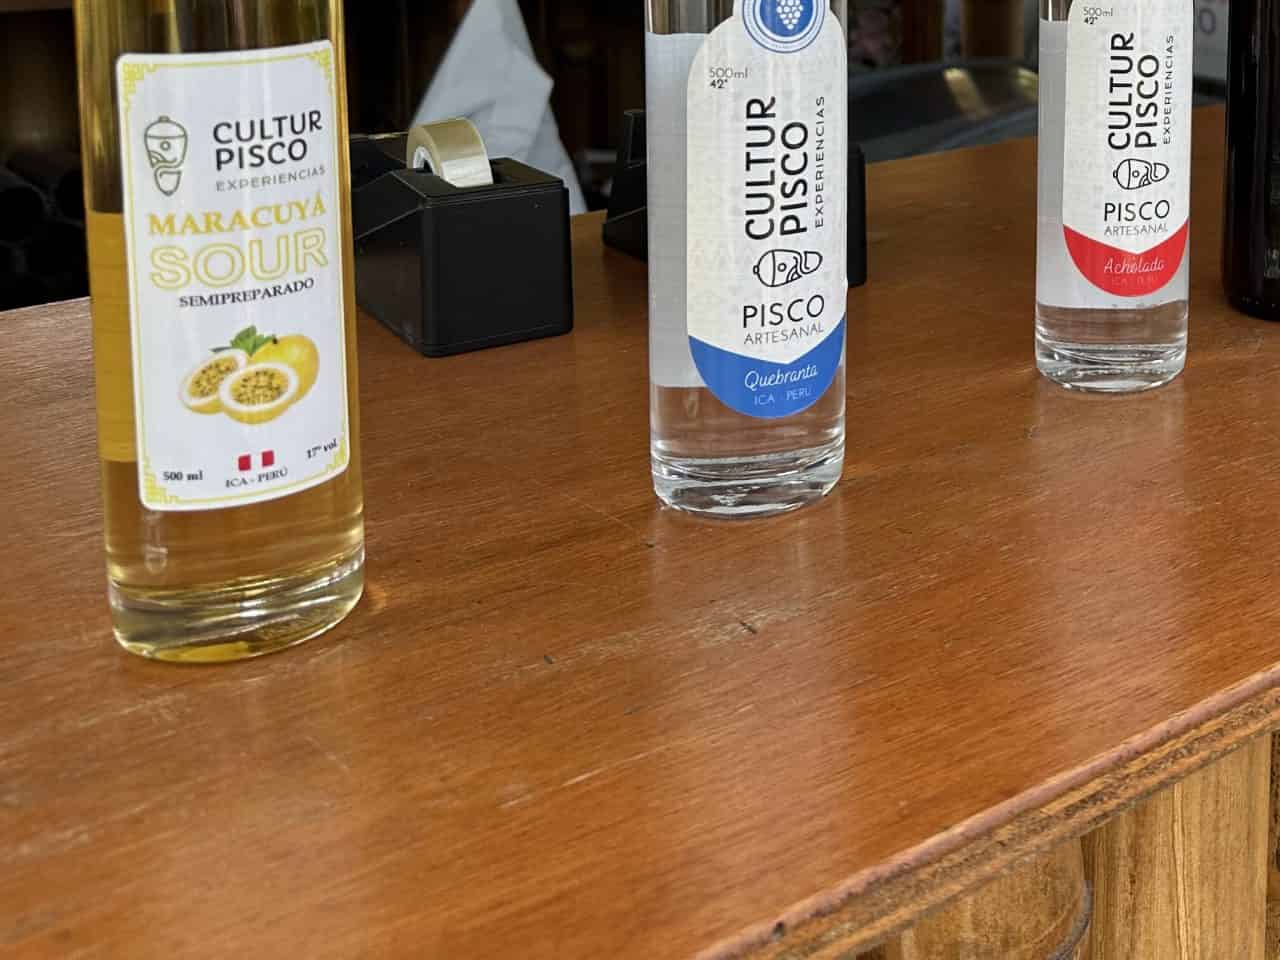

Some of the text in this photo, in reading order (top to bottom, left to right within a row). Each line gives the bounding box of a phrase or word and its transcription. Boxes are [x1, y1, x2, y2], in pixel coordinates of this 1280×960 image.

[1083, 6, 1113, 17] 500ml
[709, 67, 748, 79] 500ml
[1108, 32, 1135, 151] CULTUR
[1135, 54, 1160, 150] PISCO
[1163, 34, 1175, 145] EXPERIENCIAS
[212, 109, 323, 145] CULTUR
[214, 138, 308, 171] PISCO
[745, 96, 776, 241] CULTUR
[814, 95, 826, 229] EXPERIENCIAS
[215, 165, 326, 192] EXPERIENCIAS
[779, 121, 808, 236] PISCO
[147, 190, 328, 237] MARACUYÁ
[1103, 199, 1170, 222] PISCO
[1104, 223, 1169, 237] ARTESANAL
[150, 227, 328, 291] SOUR
[178, 277, 315, 309] SEMIPREPARADO
[743, 294, 825, 328] PISCO
[743, 321, 824, 345] ARTESANAL
[744, 363, 819, 392] Quebranta
[753, 393, 776, 406] ICA
[322, 438, 337, 452] vol
[163, 470, 203, 481] 500 ml
[225, 476, 248, 488] ICA
